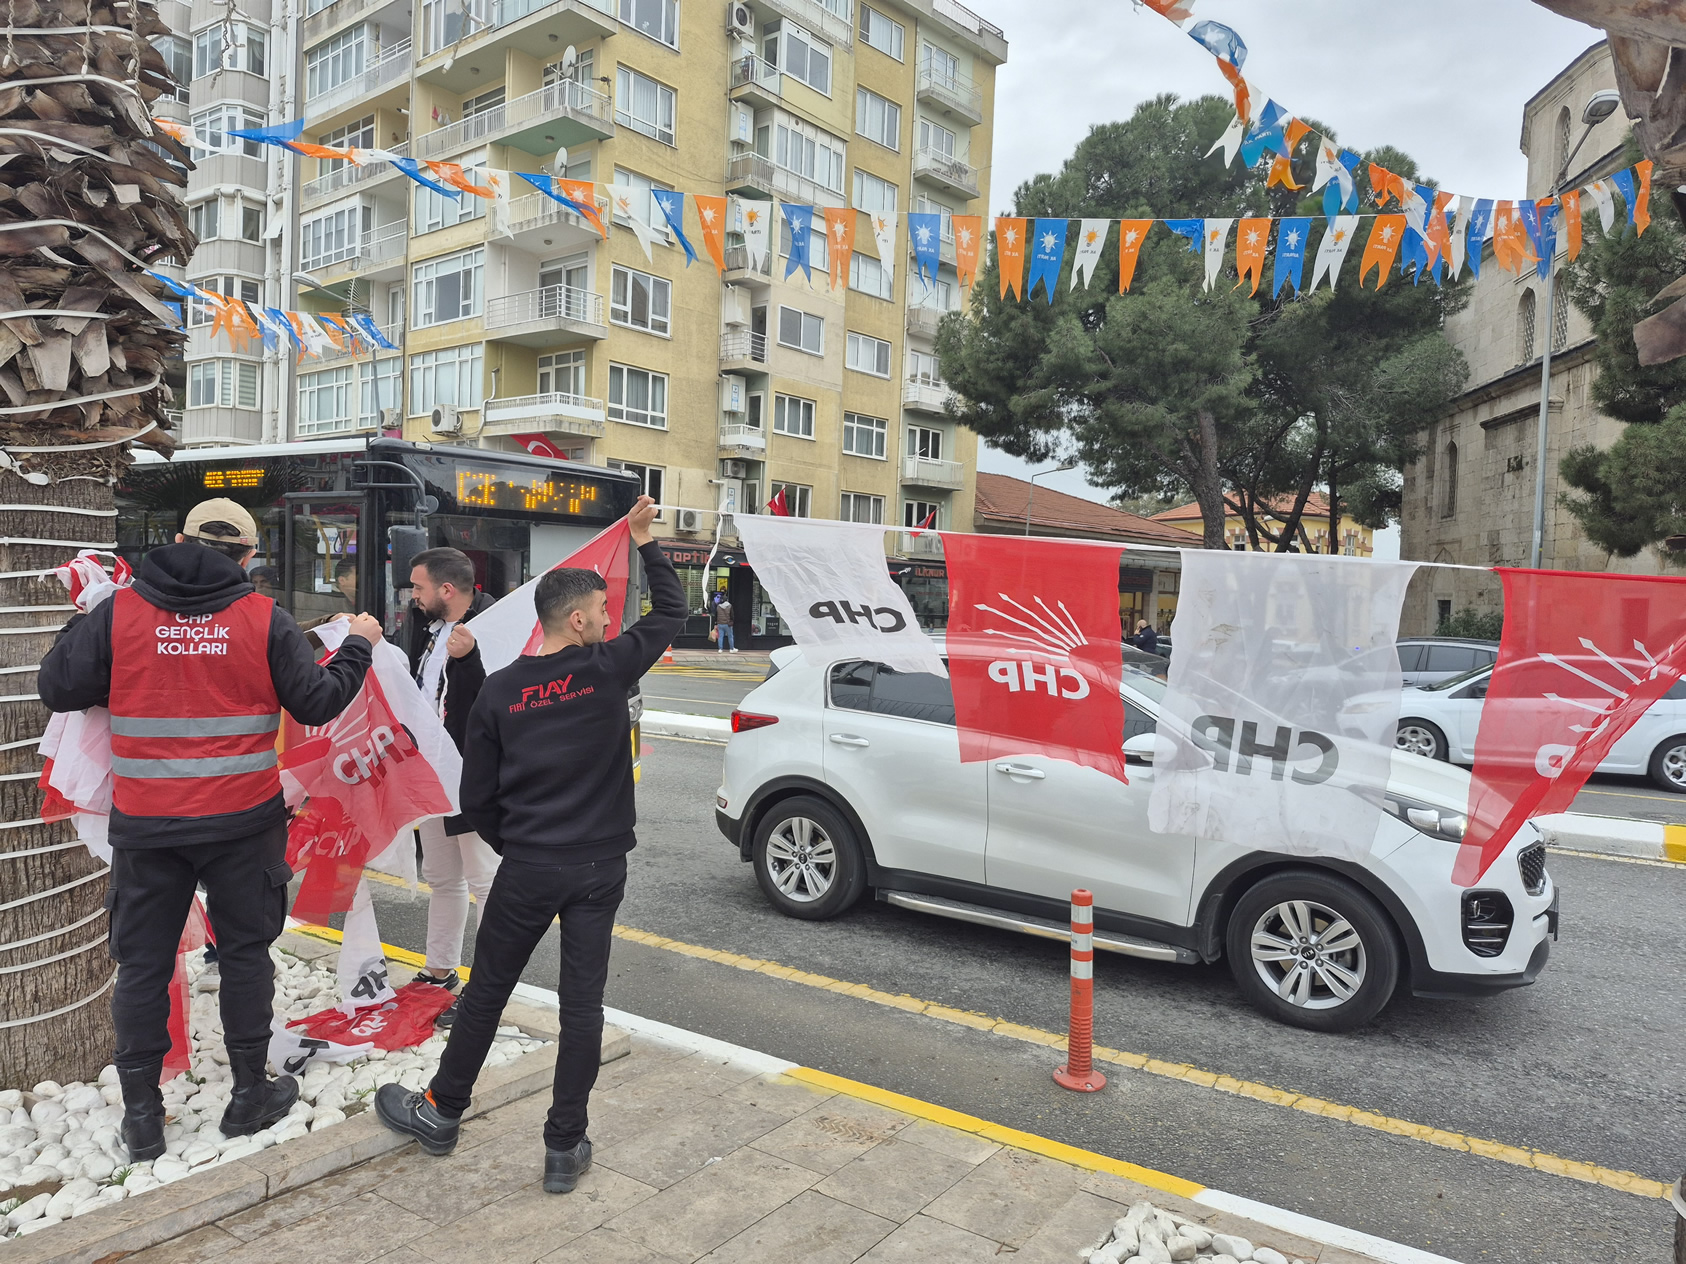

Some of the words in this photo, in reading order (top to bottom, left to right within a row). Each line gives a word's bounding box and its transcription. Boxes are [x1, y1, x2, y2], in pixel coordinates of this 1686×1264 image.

[175, 612, 213, 624] CHP
[155, 624, 230, 642] GENÇLİK
[157, 642, 228, 655] KOLLARI
[522, 674, 573, 702] FIAY
[508, 702, 526, 714] FIAT
[530, 698, 554, 708] ÖZEL
[333, 725, 395, 785] CHP
[1302, 949, 1314, 958] KIA
